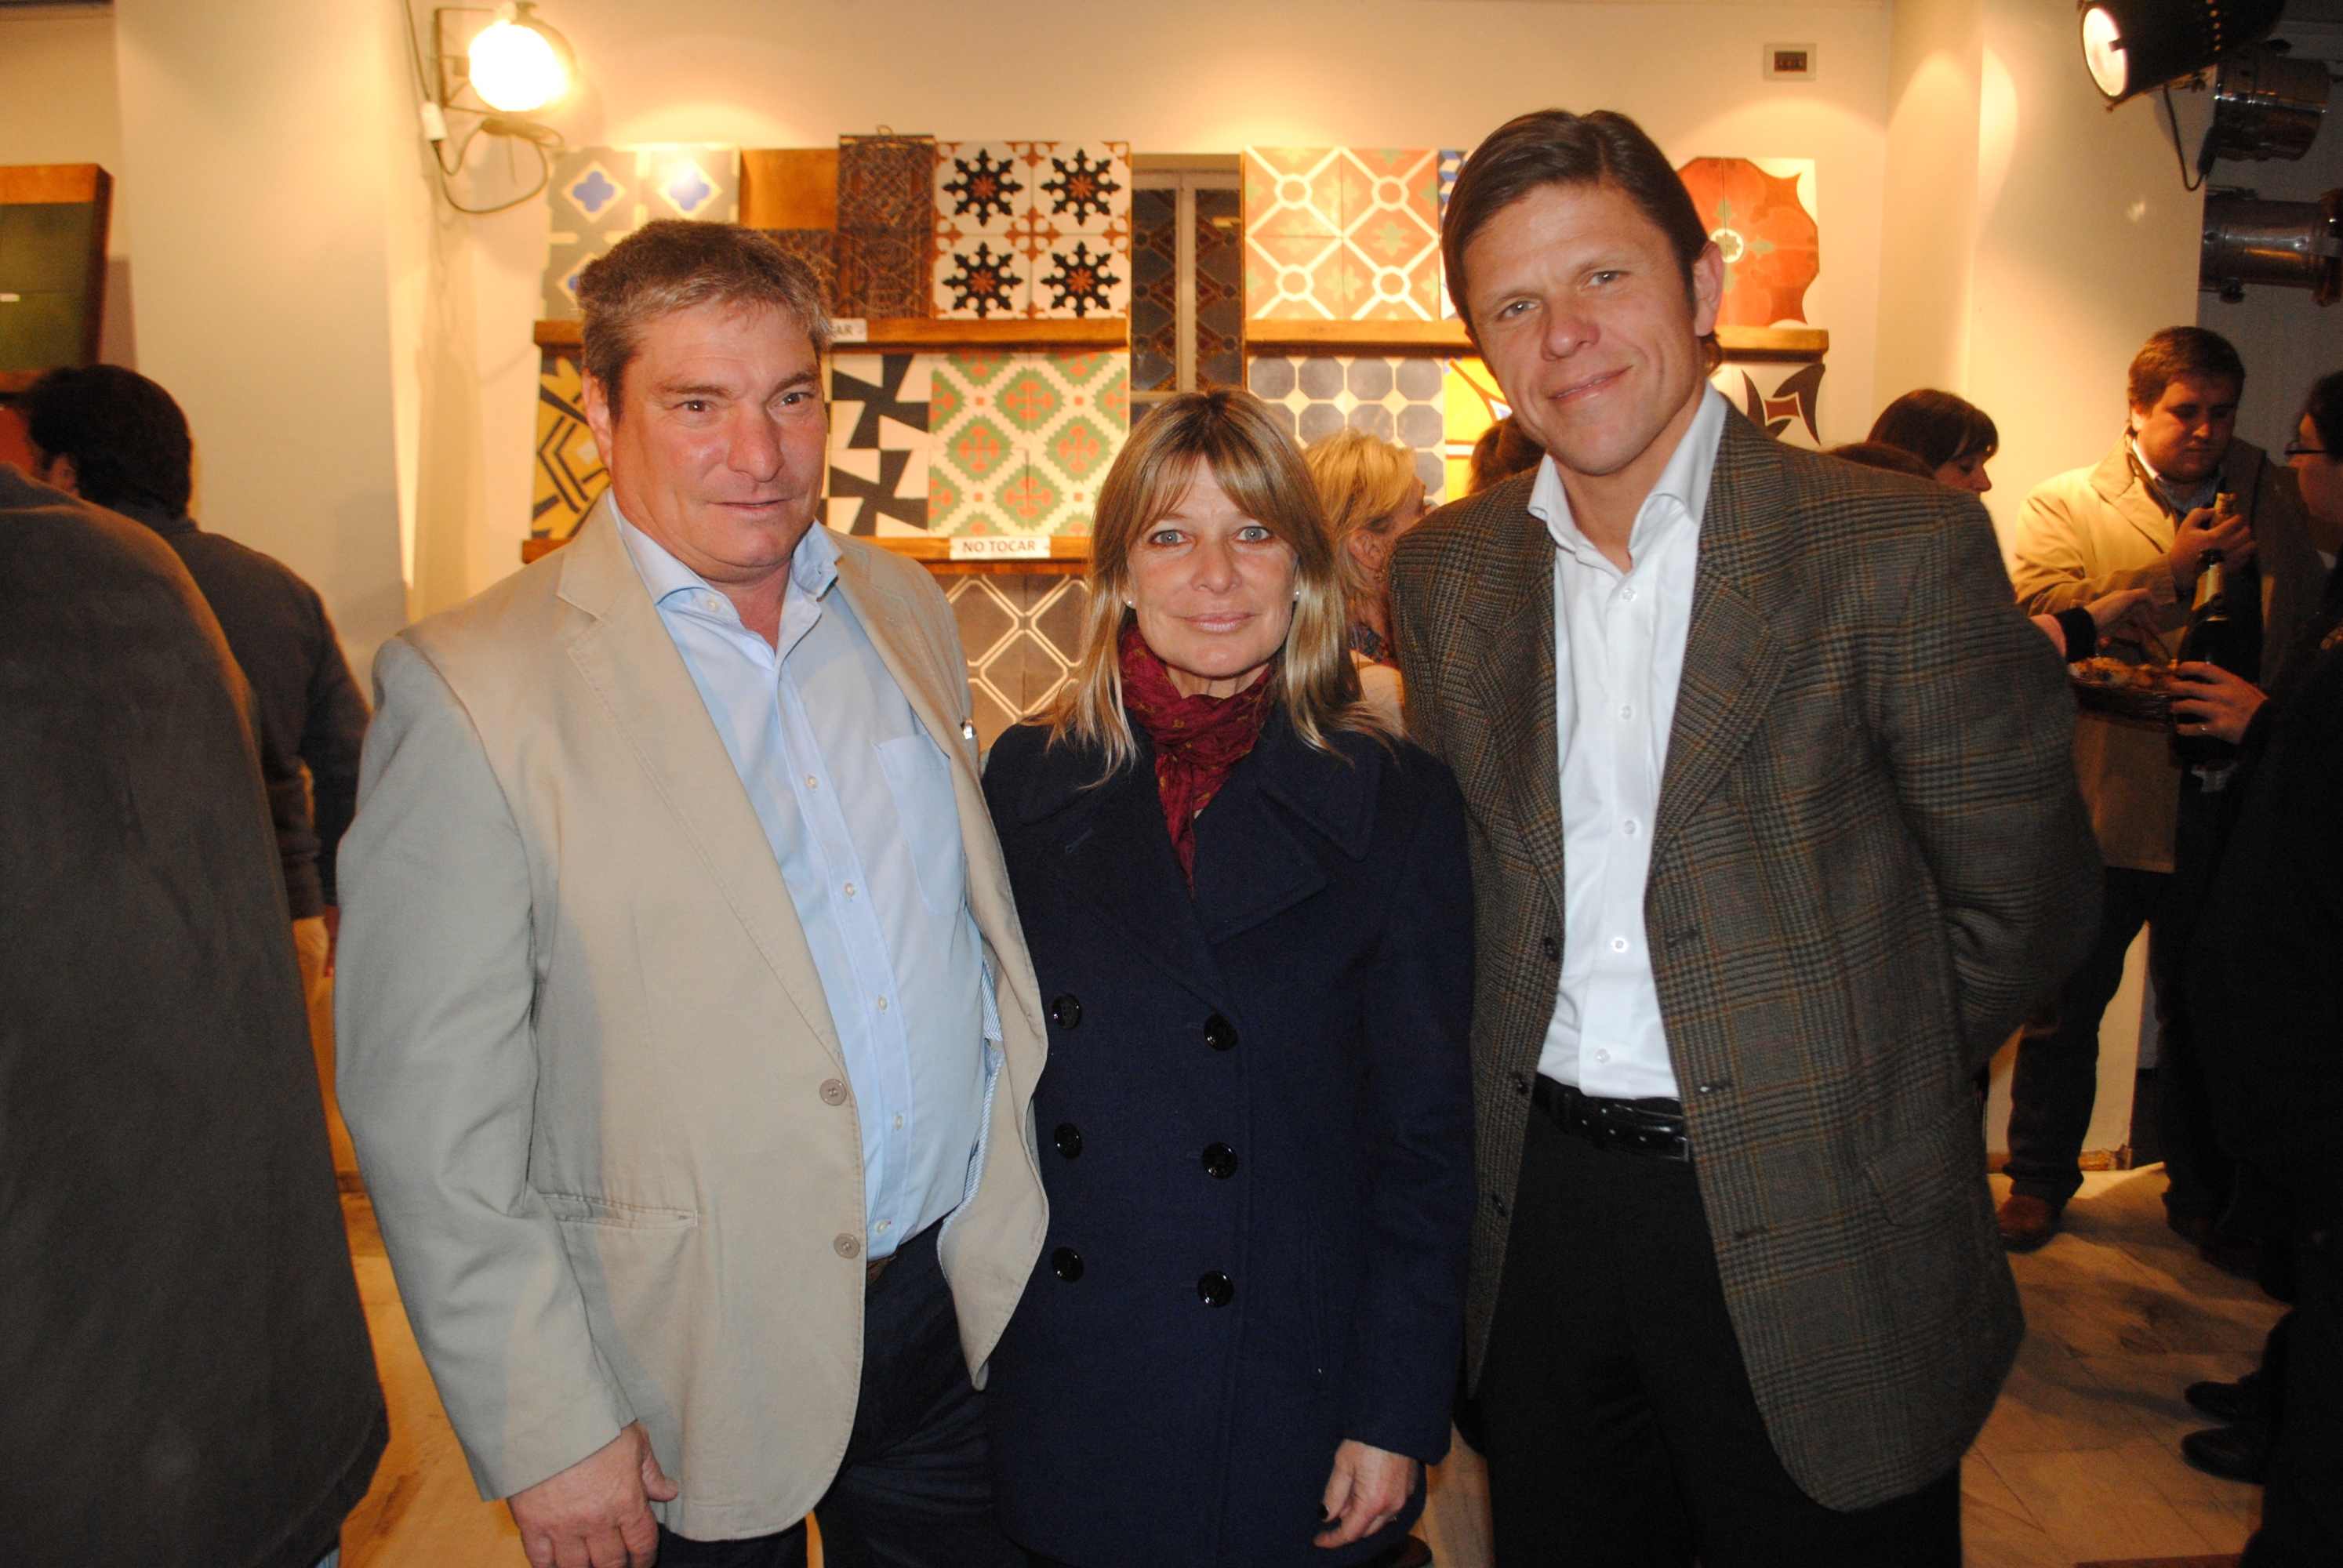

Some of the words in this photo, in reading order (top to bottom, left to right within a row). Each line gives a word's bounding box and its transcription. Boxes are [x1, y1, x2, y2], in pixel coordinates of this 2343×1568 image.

[834, 323, 853, 336] AR
[963, 540, 985, 553] NO
[988, 539, 1036, 552] TOCAR
